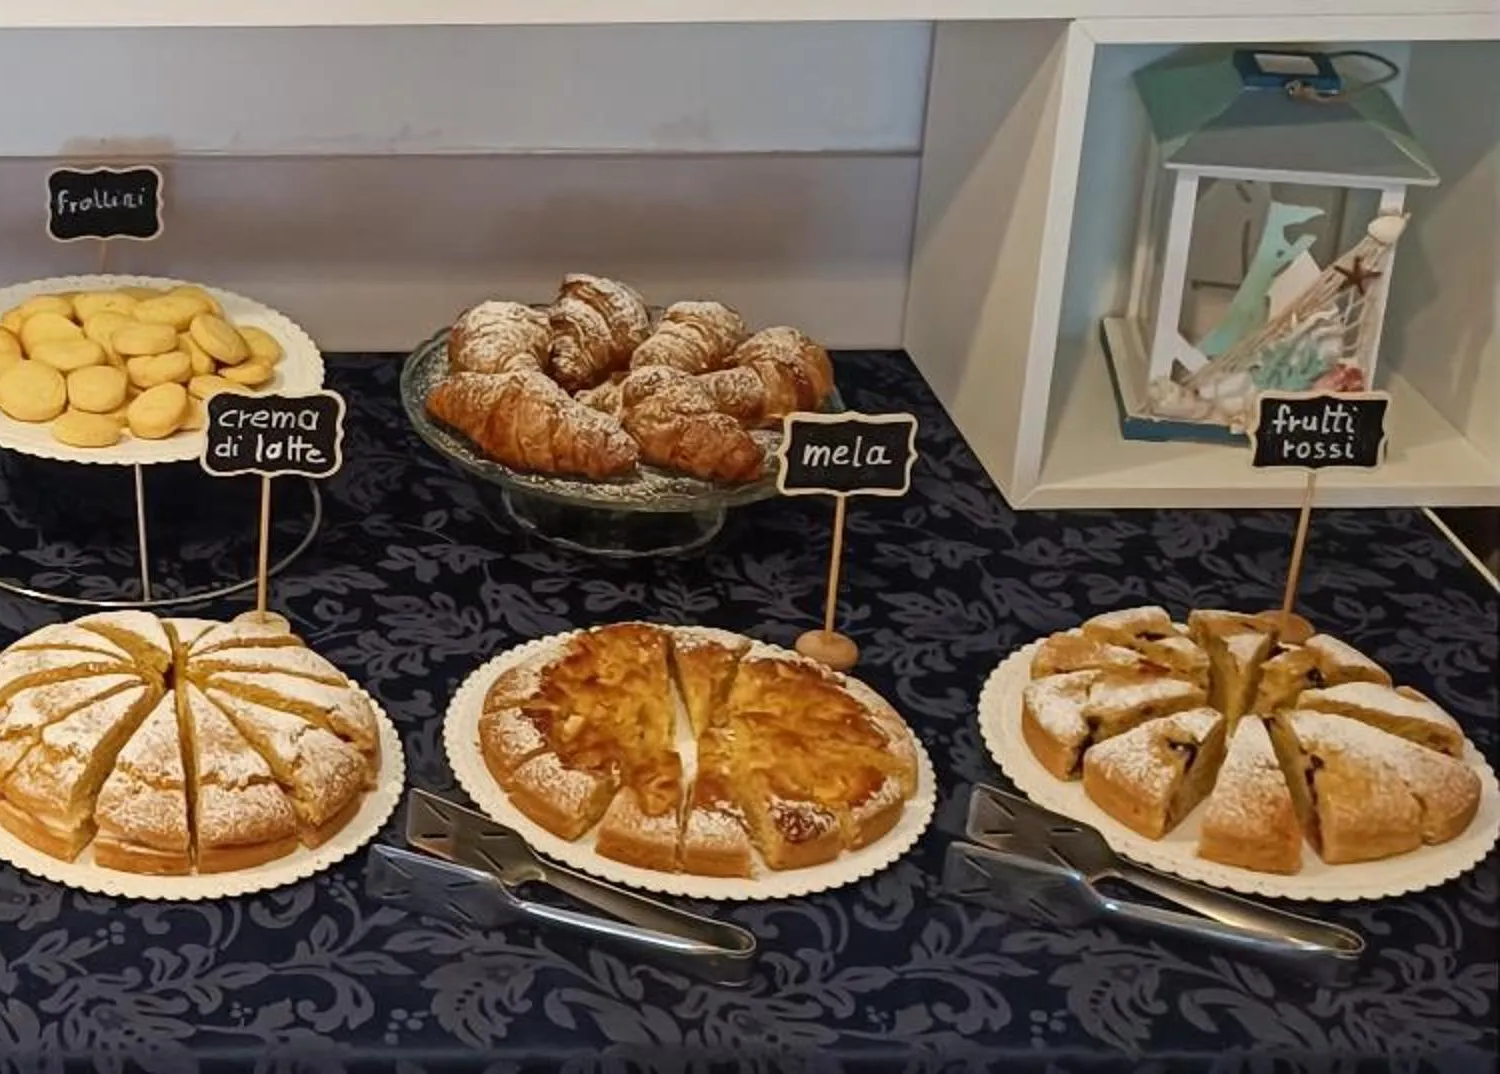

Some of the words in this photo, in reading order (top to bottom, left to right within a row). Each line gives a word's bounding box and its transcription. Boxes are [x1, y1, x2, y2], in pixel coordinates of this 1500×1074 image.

[57, 187, 146, 216] frollini
[218, 409, 319, 431] crema
[1272, 403, 1358, 435] frutti
[214, 434, 243, 458] di
[255, 433, 327, 463] latte
[801, 435, 893, 467] mela
[1283, 436, 1355, 459] rossi
